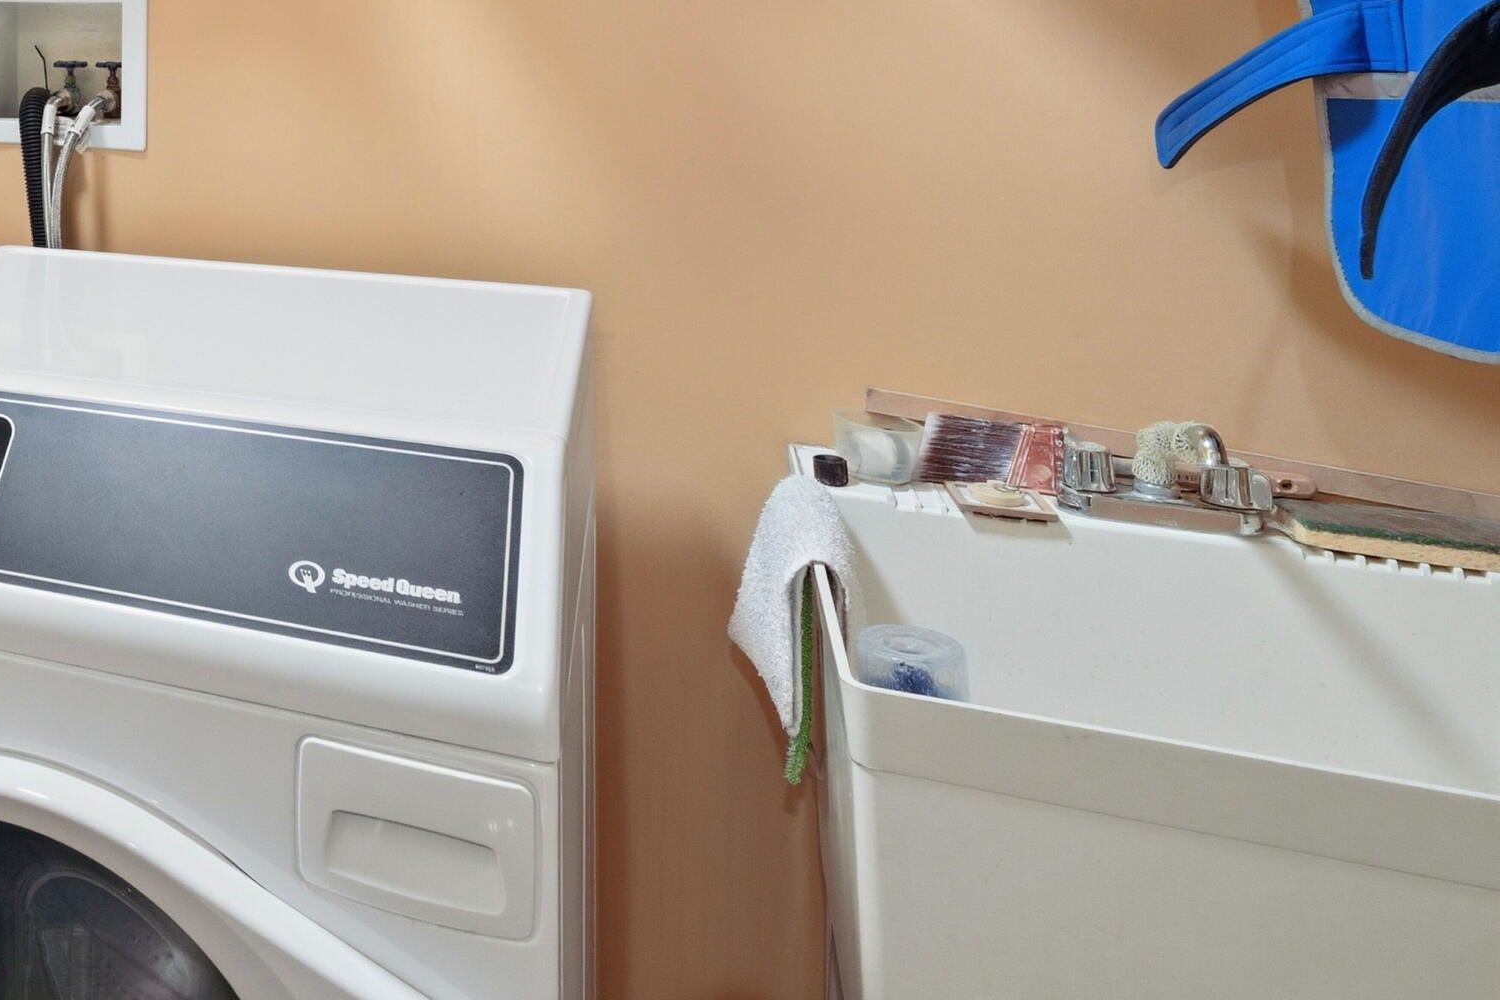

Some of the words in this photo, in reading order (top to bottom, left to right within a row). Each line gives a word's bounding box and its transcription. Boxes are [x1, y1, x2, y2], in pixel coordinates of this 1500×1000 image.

[330, 588, 391, 604] PROFESSIONAL
[393, 599, 432, 612] WASHER
[432, 605, 465, 617] SERIES
[332, 568, 395, 593] Speed
[396, 578, 462, 605] Queen
